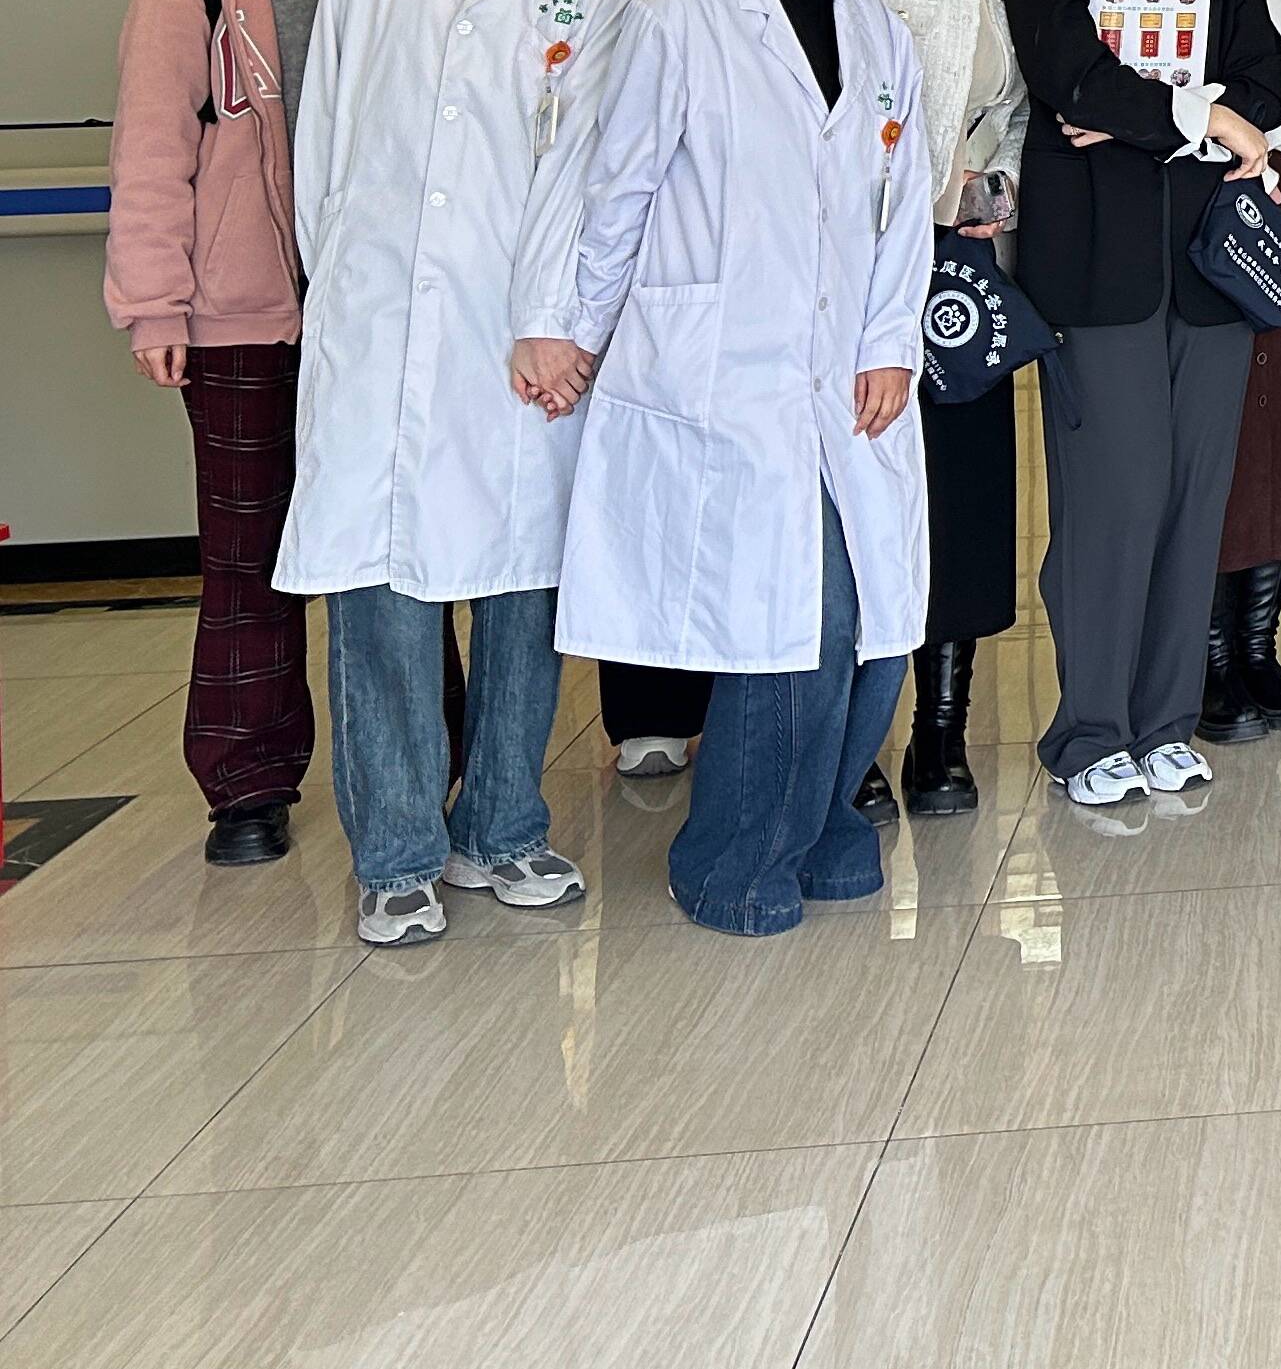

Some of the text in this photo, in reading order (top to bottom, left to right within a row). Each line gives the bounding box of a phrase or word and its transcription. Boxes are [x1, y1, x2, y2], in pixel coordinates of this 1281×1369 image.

[931, 259, 1008, 367] 庭医生签约服务
